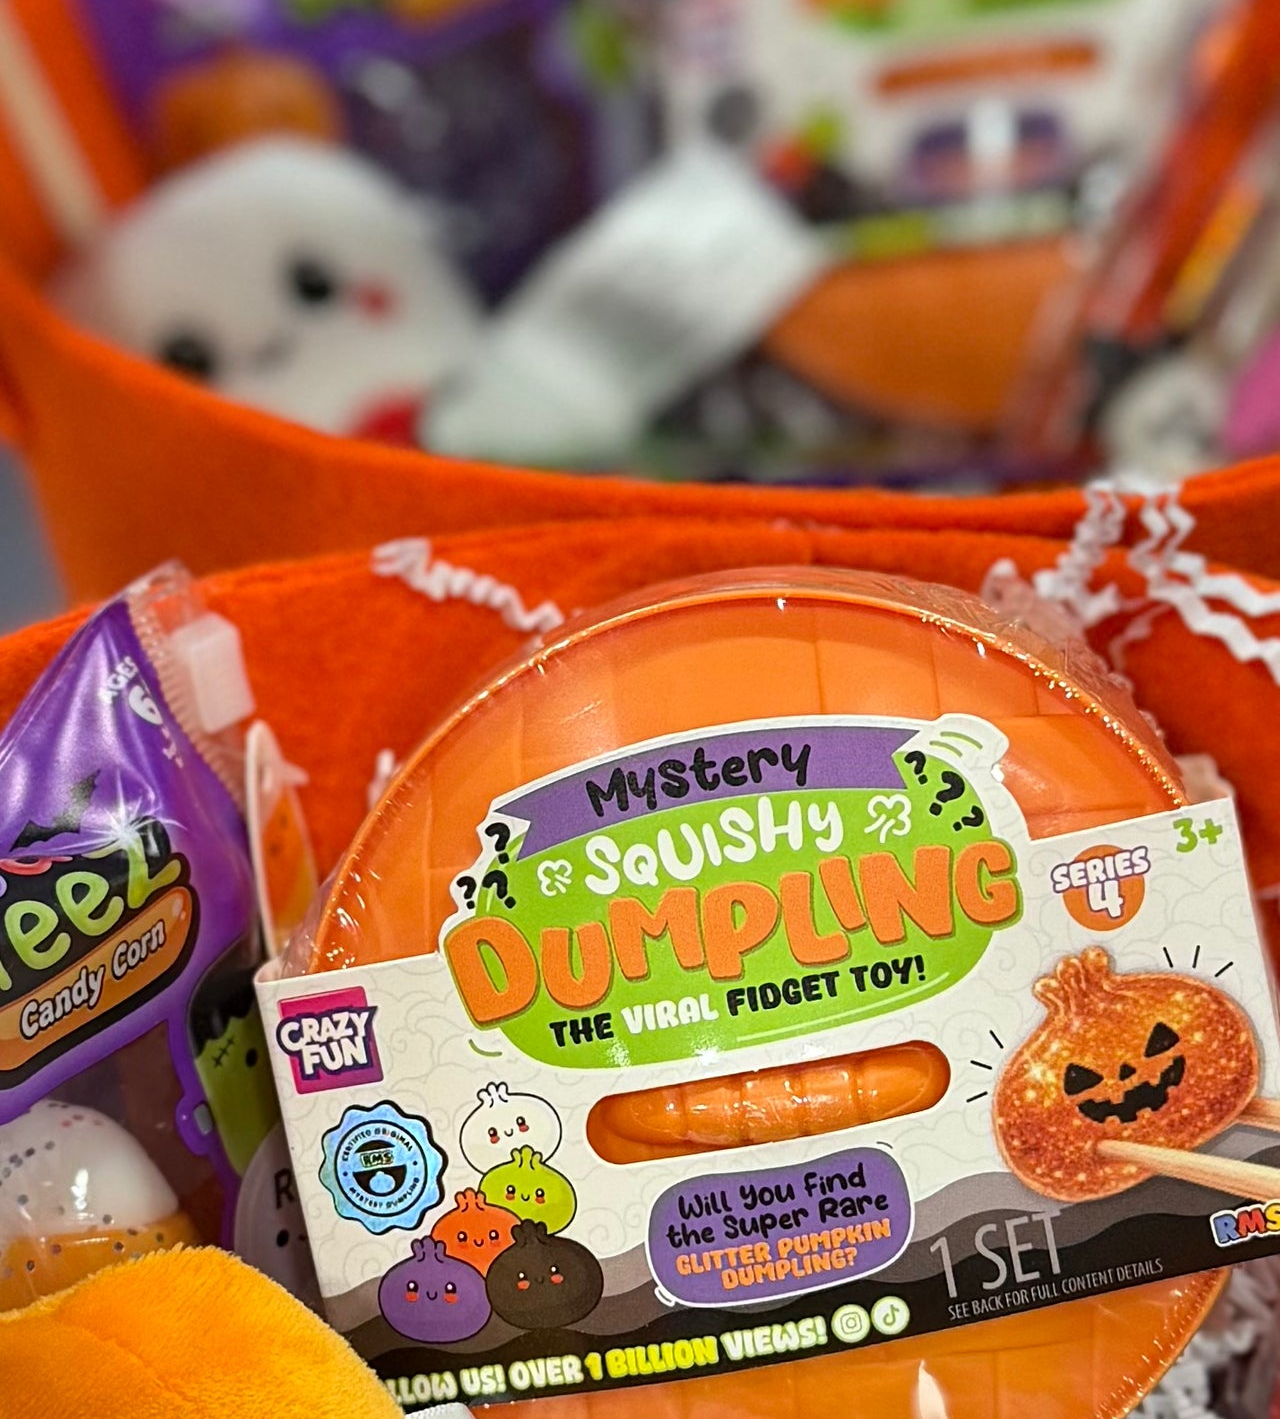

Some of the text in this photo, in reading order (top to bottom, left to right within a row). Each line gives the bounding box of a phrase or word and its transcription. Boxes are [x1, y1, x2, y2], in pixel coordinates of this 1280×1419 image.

[585, 744, 812, 817] Mystery
[1173, 819, 1222, 852] 3+
[1053, 848, 1149, 892] SERIES
[1089, 881, 1124, 917] 4
[446, 841, 1020, 1025] DUMPLING
[20, 920, 165, 1038] Candy Corn
[550, 956, 926, 1048] THE VIRAL FIDGET TOY!
[280, 1010, 370, 1051] CRAZY
[301, 1037, 367, 1075] FUN
[667, 1194, 889, 1248] the Super Rare
[678, 1190, 733, 1221] Will
[676, 1218, 891, 1276] GLITTER PUMPKIN
[721, 1247, 857, 1290] DUMPLING?
[929, 1210, 1061, 1298] 1 SET
[948, 1258, 1163, 1320] SEE BACK FOR FULL CONTENT DETAILS
[384, 1317, 827, 1404] LLOW US! OVER 1 BILLION VIEWS!
